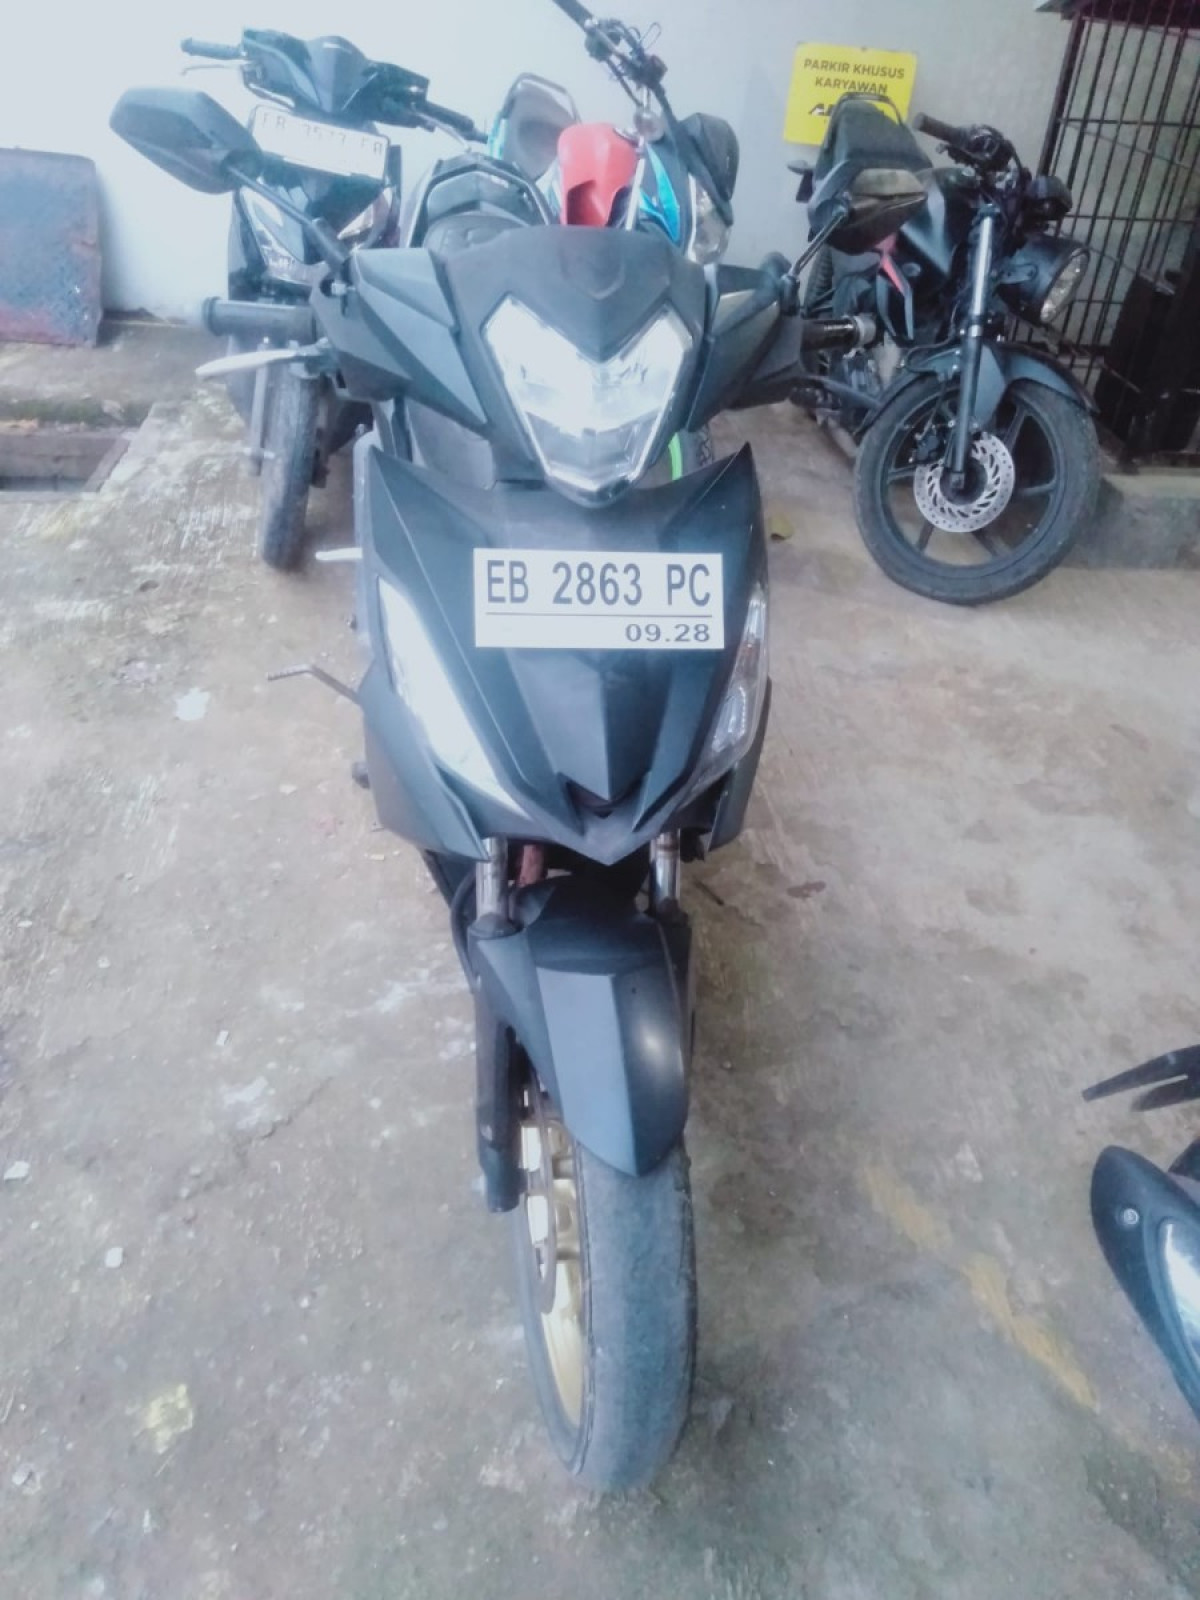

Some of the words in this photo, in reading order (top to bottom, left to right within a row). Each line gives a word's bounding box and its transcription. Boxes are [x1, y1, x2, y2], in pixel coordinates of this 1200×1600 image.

[803, 58, 850, 73] PARKIR
[853, 63, 905, 79] KHUSUS
[815, 76, 888, 94] KARYAWAN
[487, 559, 529, 604] EB
[552, 561, 643, 606] 2863
[666, 563, 711, 607] PC
[625, 623, 711, 642] 09.28
